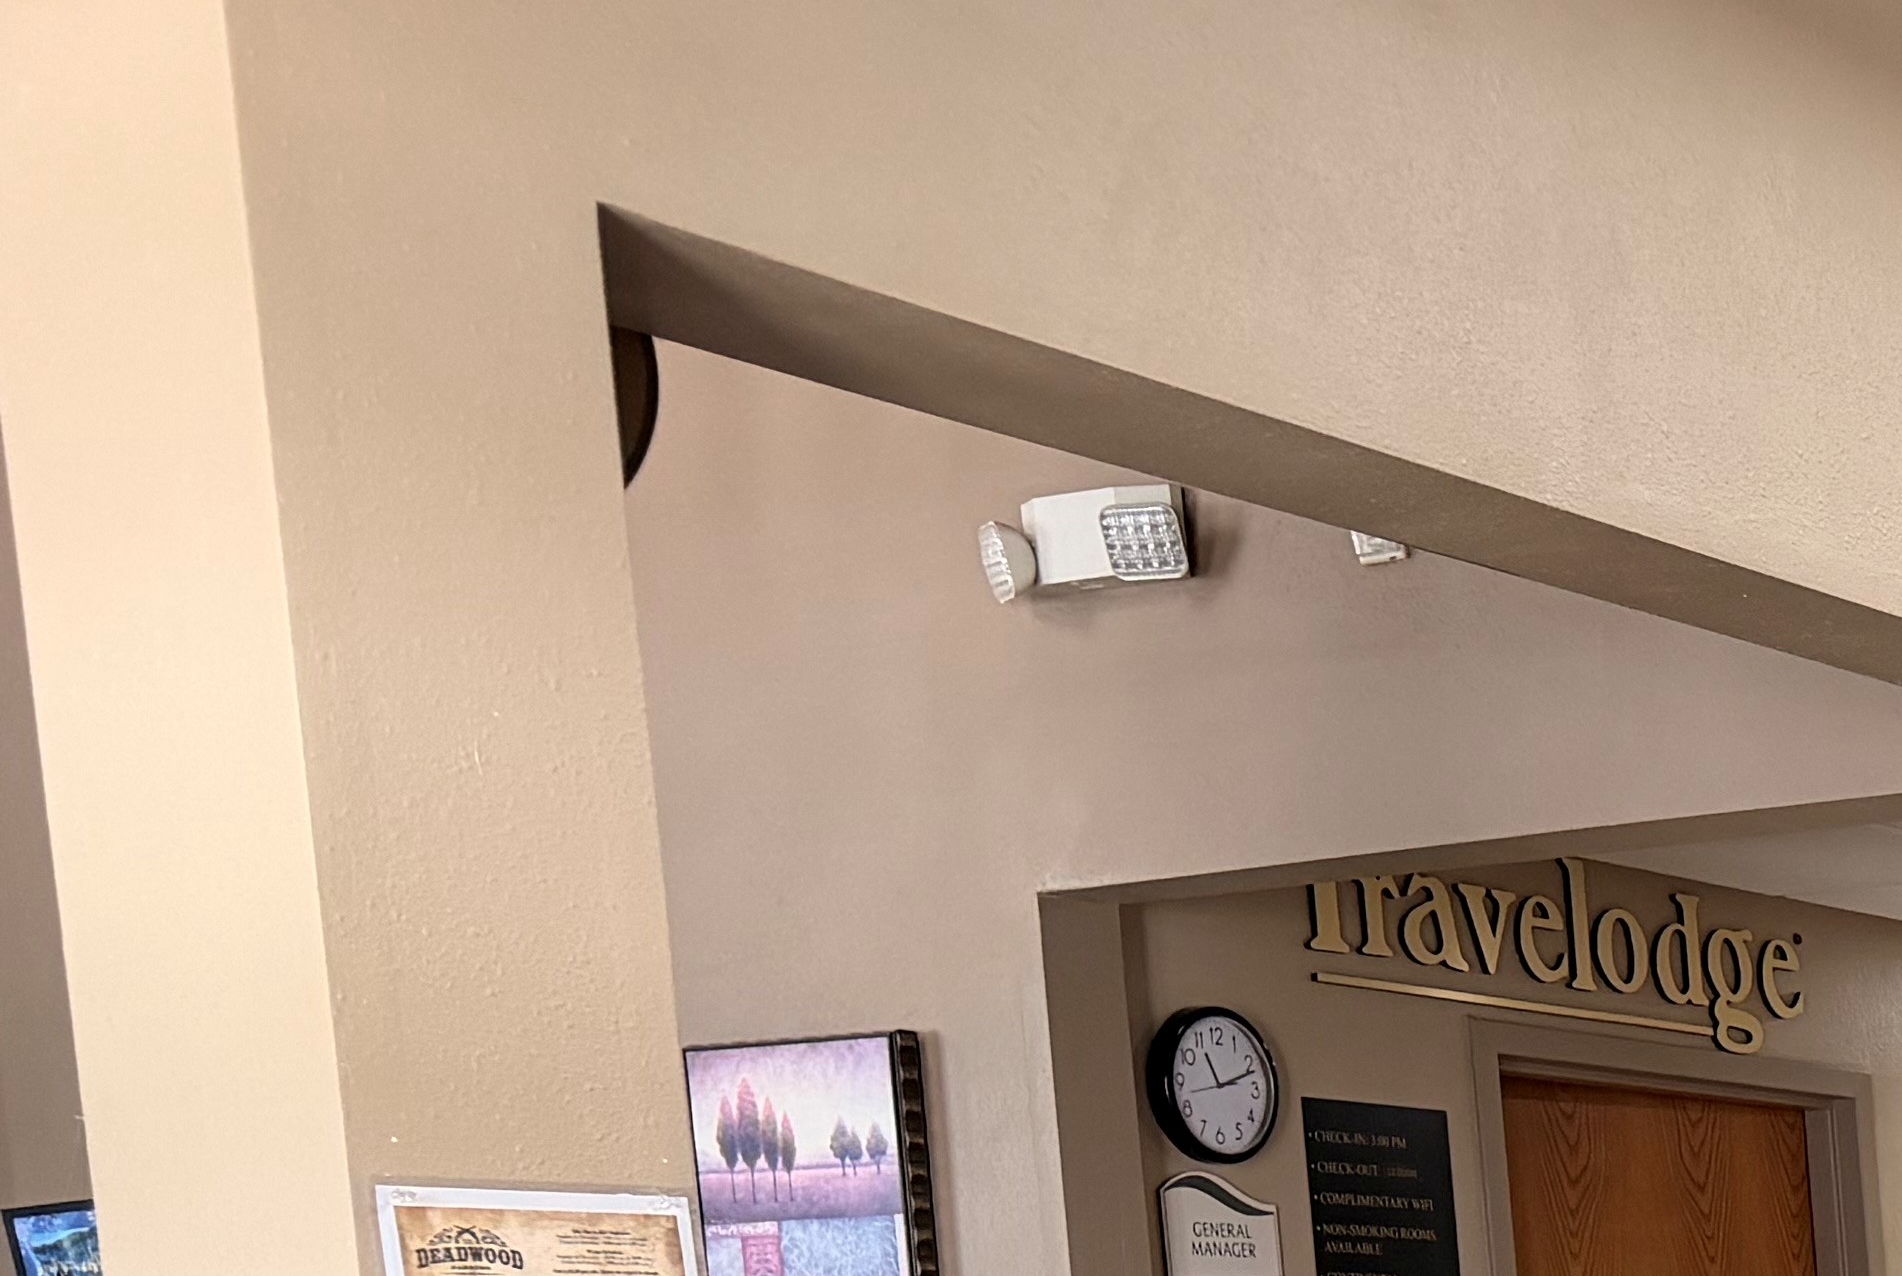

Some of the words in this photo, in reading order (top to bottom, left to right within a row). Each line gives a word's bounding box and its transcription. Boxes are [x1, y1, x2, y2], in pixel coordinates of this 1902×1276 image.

[1307, 857, 1803, 1053] Travelodge
[1194, 1032, 1203, 1049] 11
[1209, 1027, 1223, 1046] 12
[1232, 1035, 1236, 1053] 1
[1180, 1049, 1195, 1066] 10
[1175, 1072, 1185, 1091] 9
[1251, 1081, 1260, 1099] 3
[1183, 1100, 1193, 1118] 8
[1247, 1109, 1254, 1124] 4
[1200, 1119, 1207, 1137] 7
[1215, 1127, 1225, 1144] 6
[1235, 1123, 1243, 1140] 5
[1193, 1222, 1252, 1239] GENERAL
[416, 1247, 524, 1270] DEADWOOD
[1191, 1242, 1257, 1258] MANAGER
